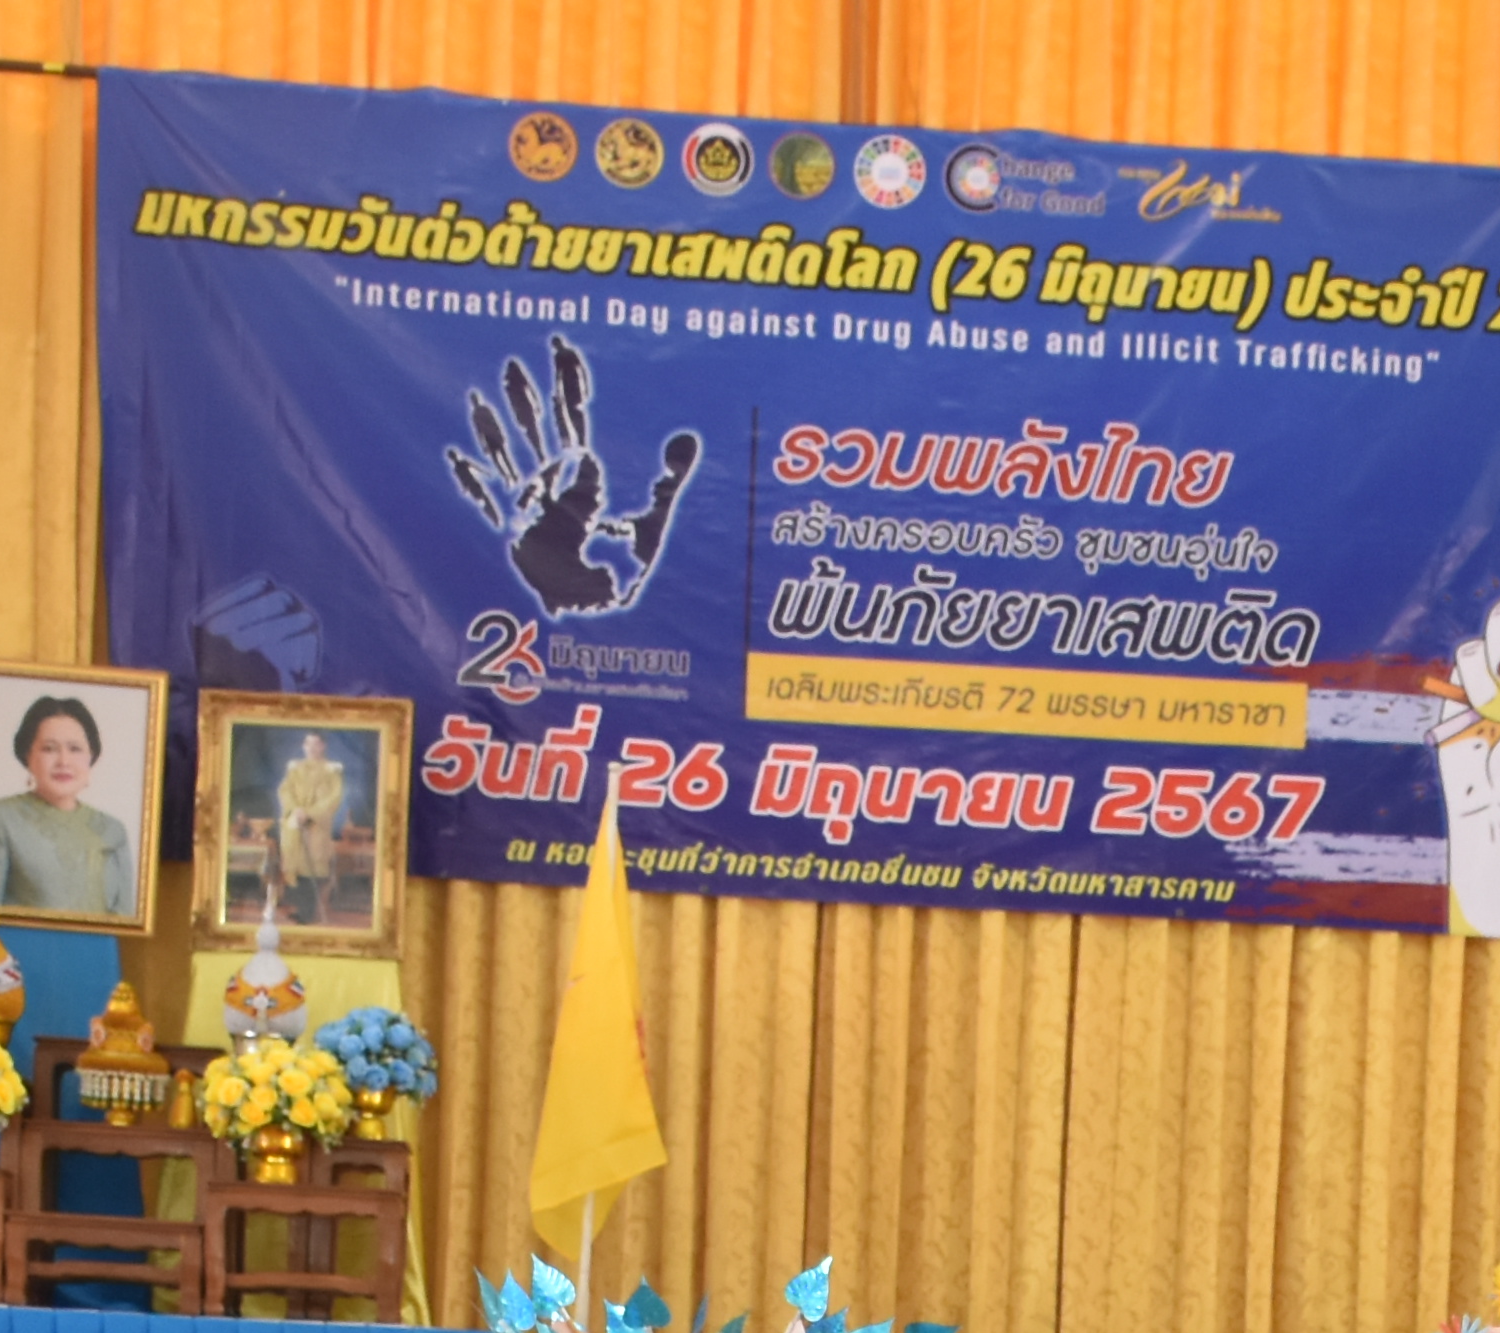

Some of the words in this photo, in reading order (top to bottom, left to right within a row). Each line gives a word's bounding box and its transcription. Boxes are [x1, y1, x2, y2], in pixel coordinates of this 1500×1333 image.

[930, 238, 1034, 313] (26
[1039, 244, 1271, 332] มิถุนายน)
[1283, 258, 1487, 331] ประจำปี
[606, 297, 670, 335] Day
[686, 307, 818, 342] against
[832, 315, 913, 349] Drug
[928, 323, 1030, 356] Abuse
[1045, 329, 1106, 359] and
[1121, 331, 1220, 366] Illicit
[773, 417, 1236, 510] รวมพลังไทย
[771, 501, 1064, 560] สร้างครอบครัว
[1075, 521, 1279, 581] ชุมชนอุ่นใจ
[767, 555, 1323, 668] พ้นภัยยาเสพติด
[549, 633, 692, 681] มิถุนายน
[765, 671, 988, 715] เฉลิมพระเกียรติ
[997, 685, 1037, 714] 72
[1045, 691, 1147, 721] พรรษา
[1157, 696, 1288, 728] มหาราชา
[421, 703, 603, 804] วันที่
[613, 736, 729, 812] 26
[749, 743, 1075, 846] มิถุนายน
[1090, 766, 1327, 842] 2567
[506, 838, 538, 863] ณ
[972, 856, 1237, 903] จังหวัดมหาสารคาม
